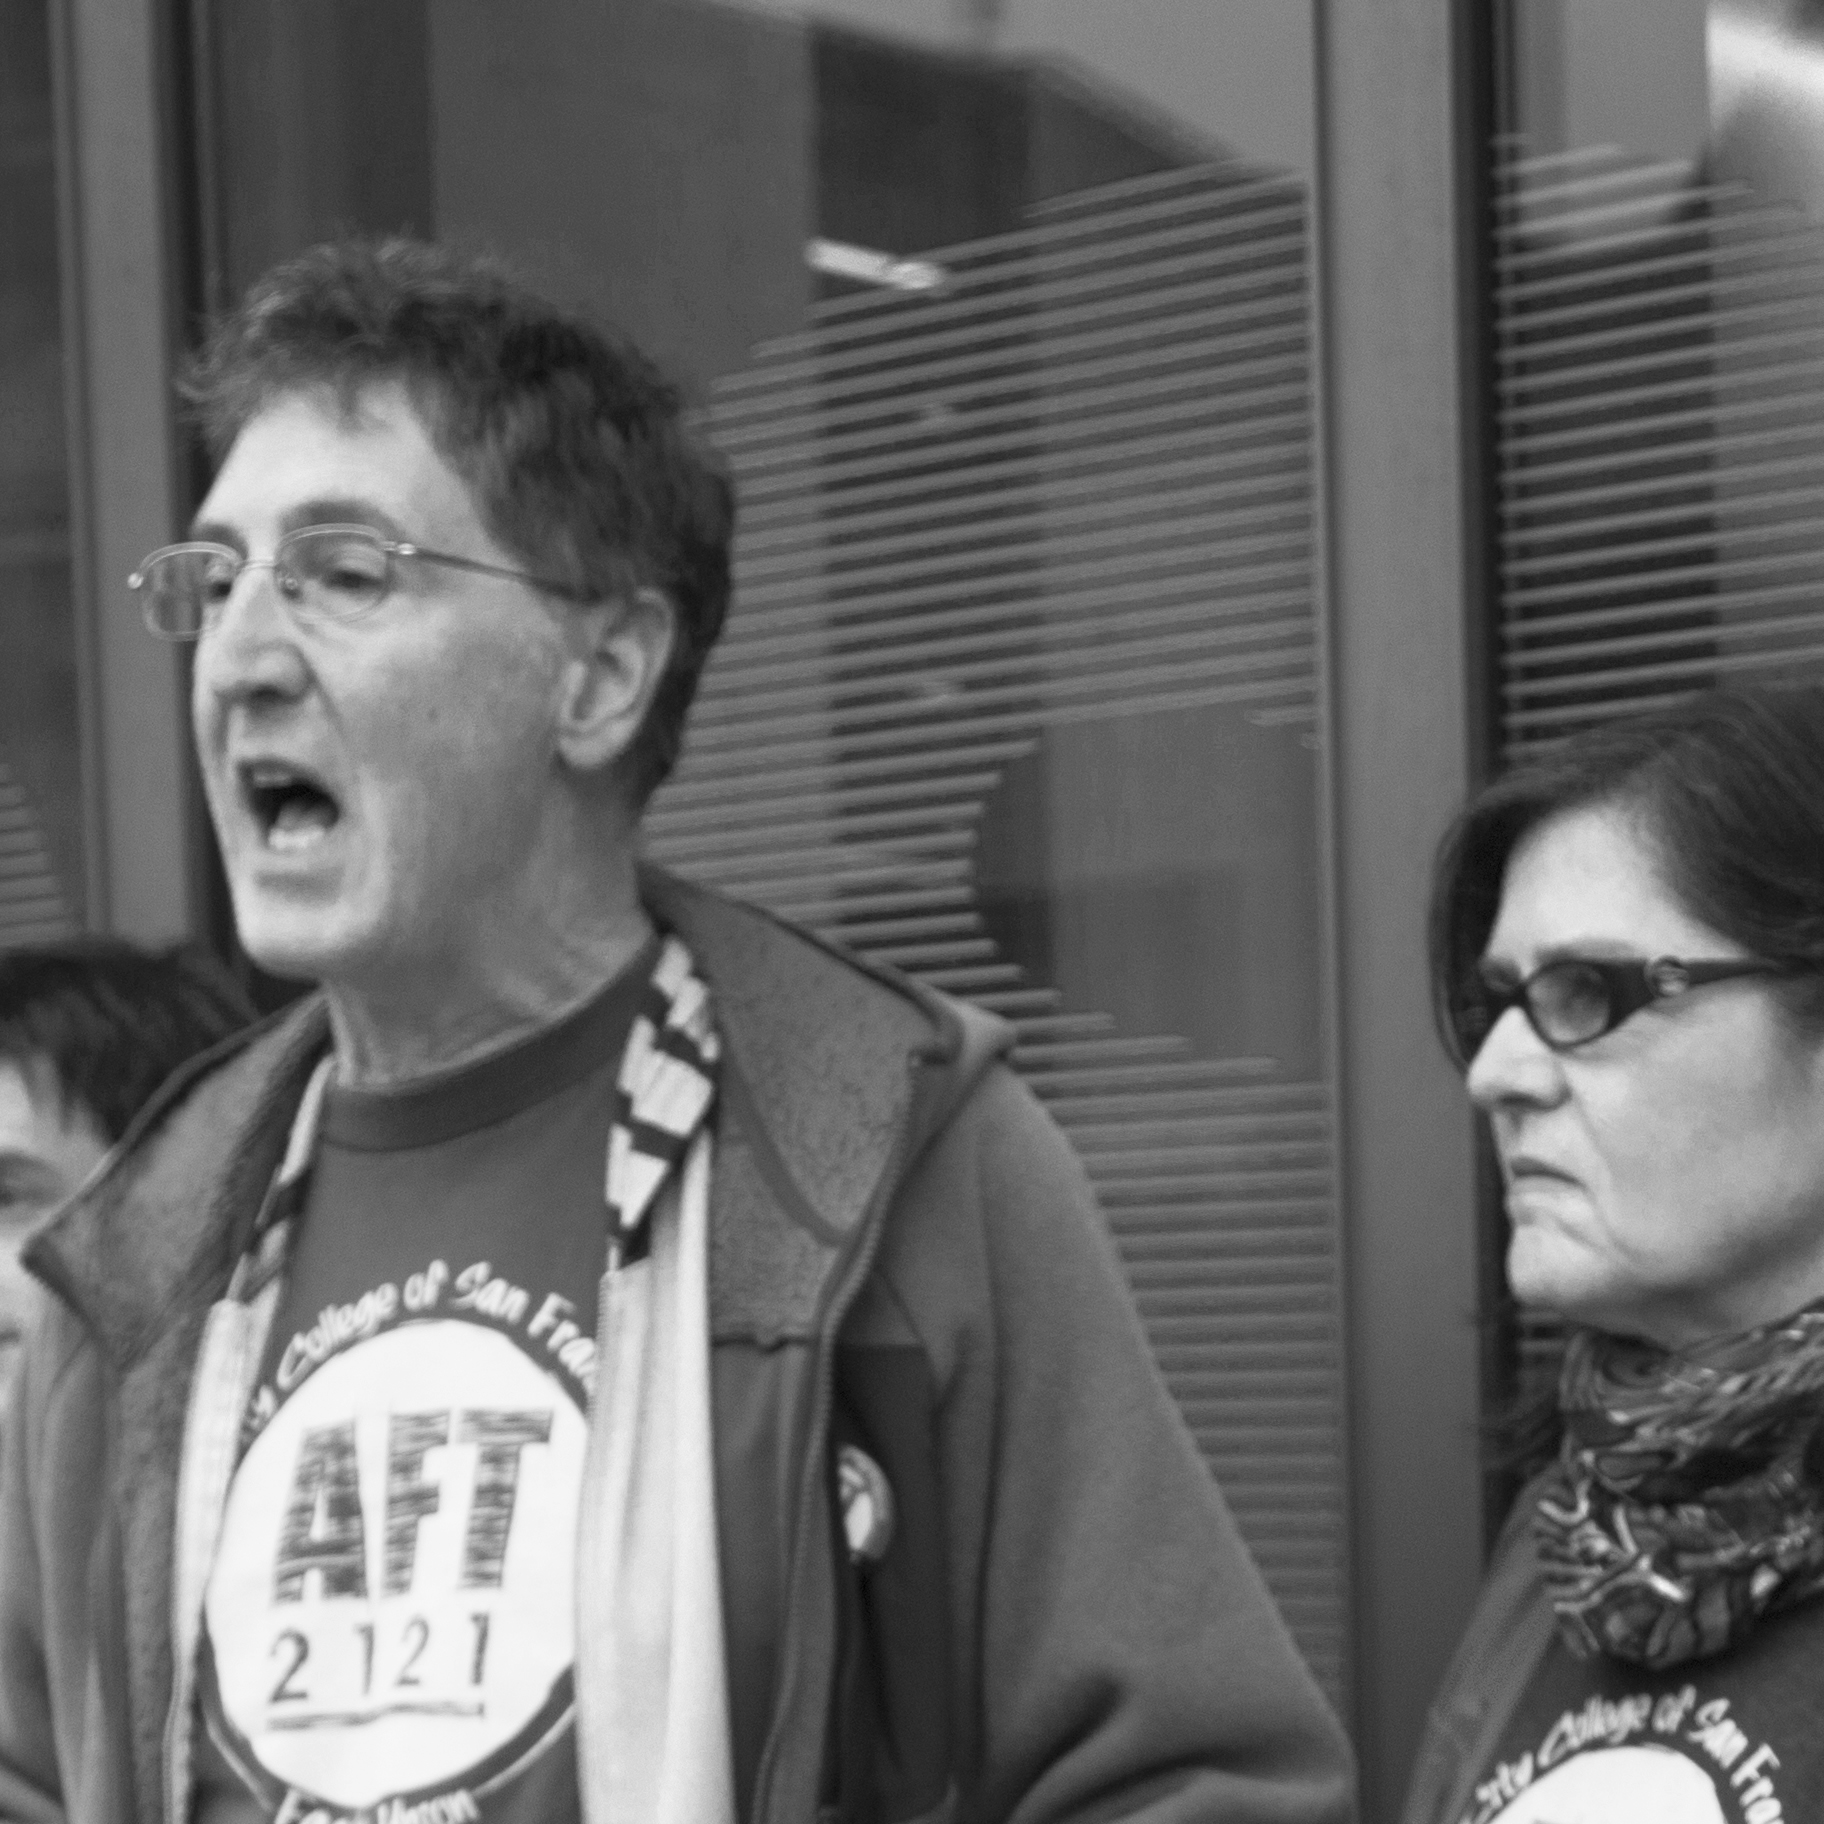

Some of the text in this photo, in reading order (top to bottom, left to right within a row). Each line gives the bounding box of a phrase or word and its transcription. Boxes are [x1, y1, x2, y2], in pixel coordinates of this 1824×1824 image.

[403, 1258, 449, 1312] of
[449, 1260, 529, 1325] San
[270, 1407, 555, 1606] AFT
[267, 1612, 492, 1704] 2121
[1684, 1698, 1750, 1770] San
